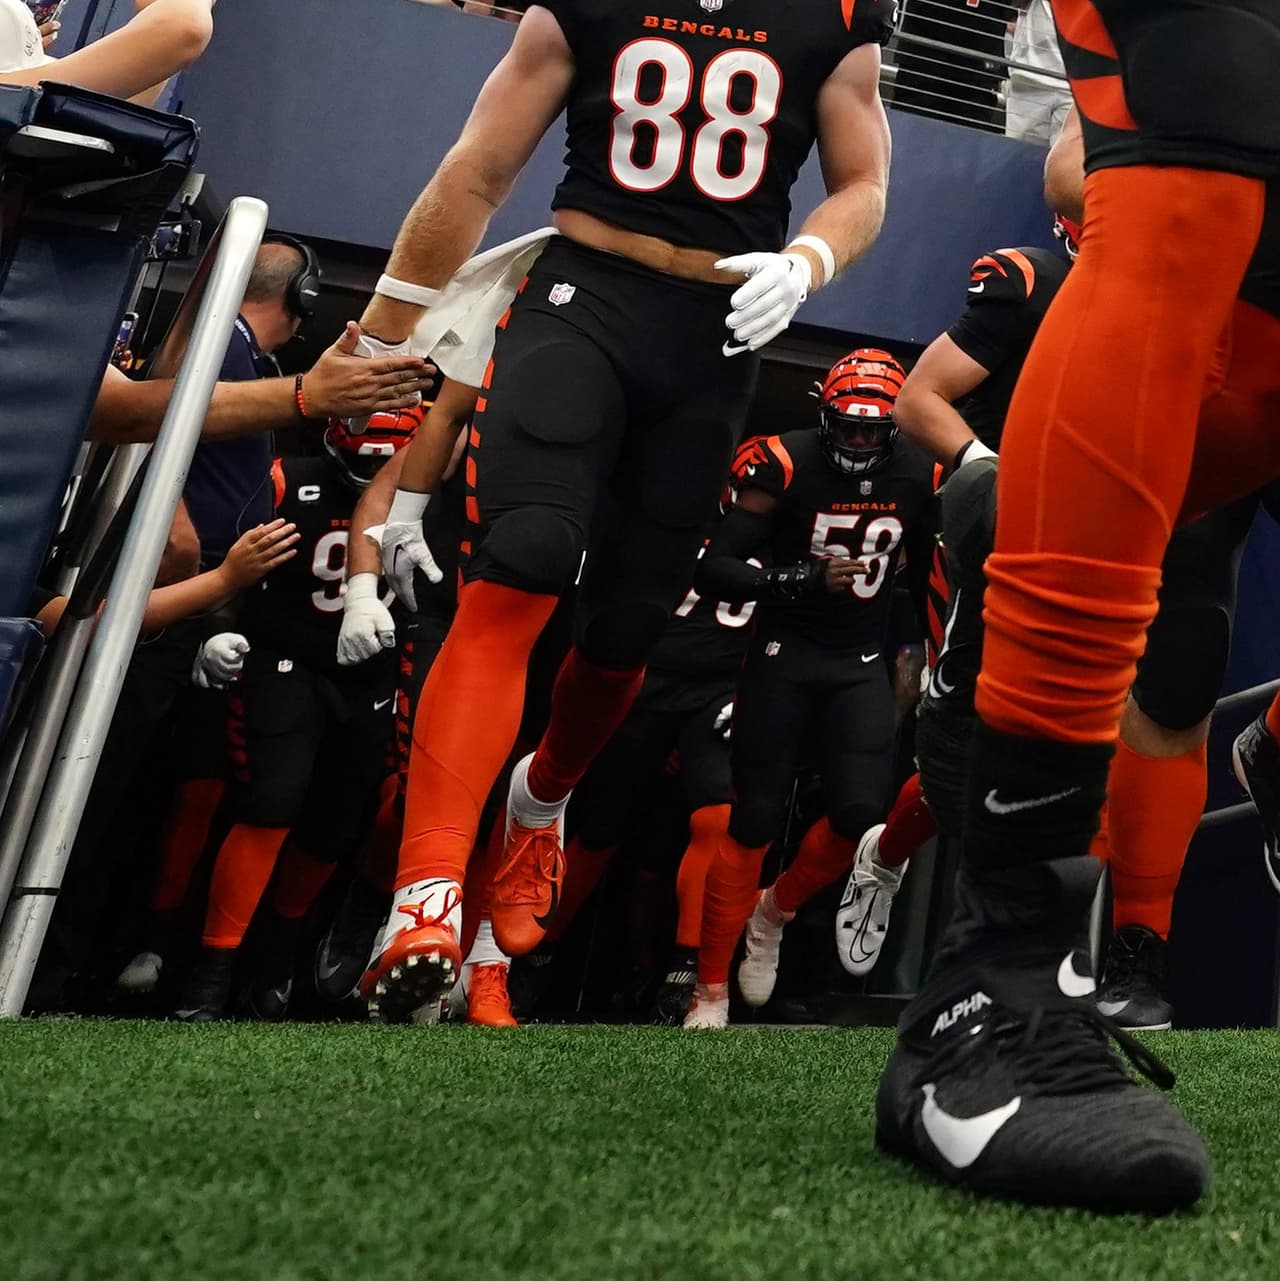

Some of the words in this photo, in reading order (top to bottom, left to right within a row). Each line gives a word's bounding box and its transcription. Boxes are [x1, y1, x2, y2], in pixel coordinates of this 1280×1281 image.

[642, 15, 769, 45] BENGALS
[608, 36, 784, 203] 88
[297, 484, 321, 502] C
[832, 501, 898, 511] BENGALS
[810, 511, 904, 600] 58
[930, 991, 993, 1037] ALPHA
